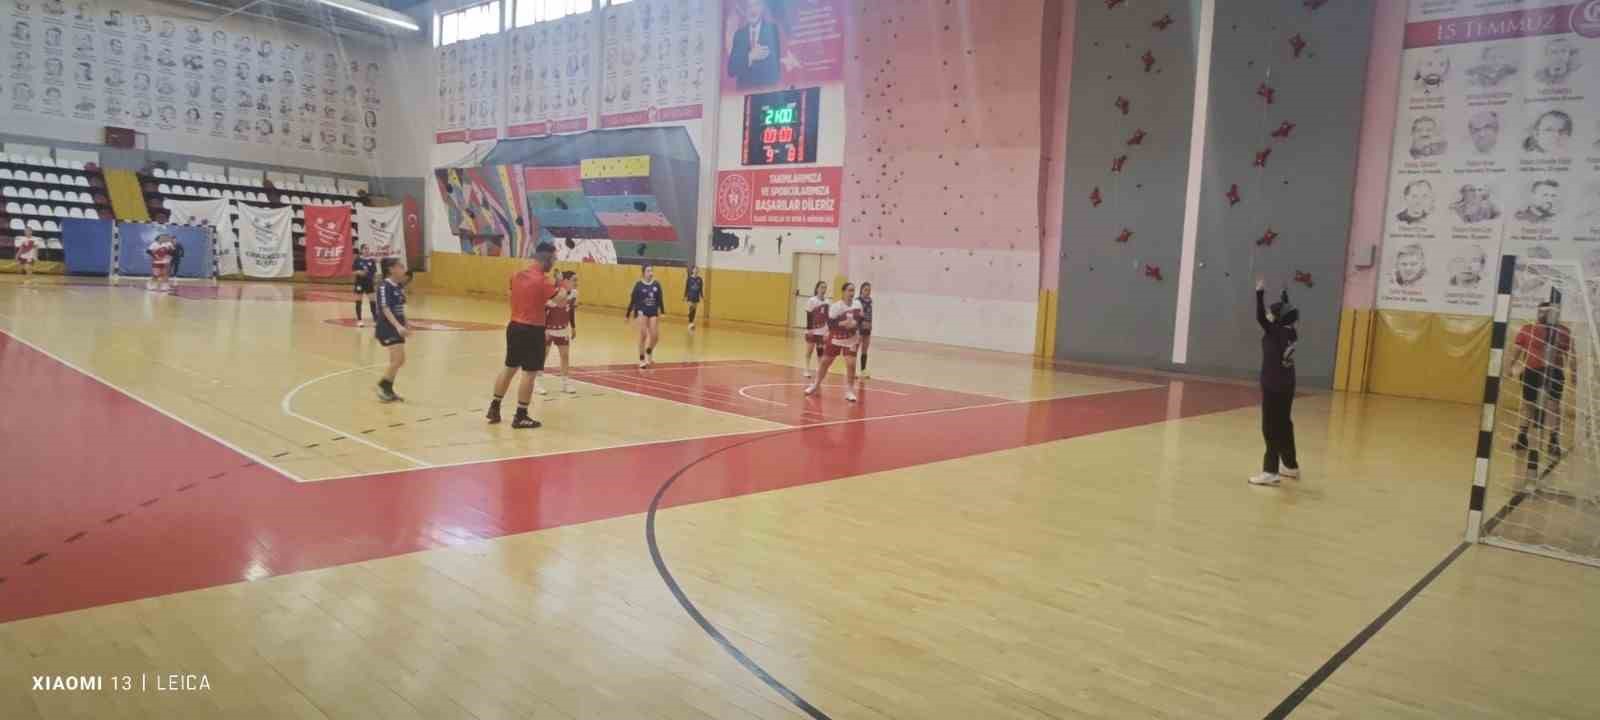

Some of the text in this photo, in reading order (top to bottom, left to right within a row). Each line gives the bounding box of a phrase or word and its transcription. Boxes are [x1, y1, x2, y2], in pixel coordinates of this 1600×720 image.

[1465, 13, 1555, 39] TEMMUZ
[755, 196, 835, 212] BAŞARILAR DİLERİZ
[314, 246, 344, 257] THF
